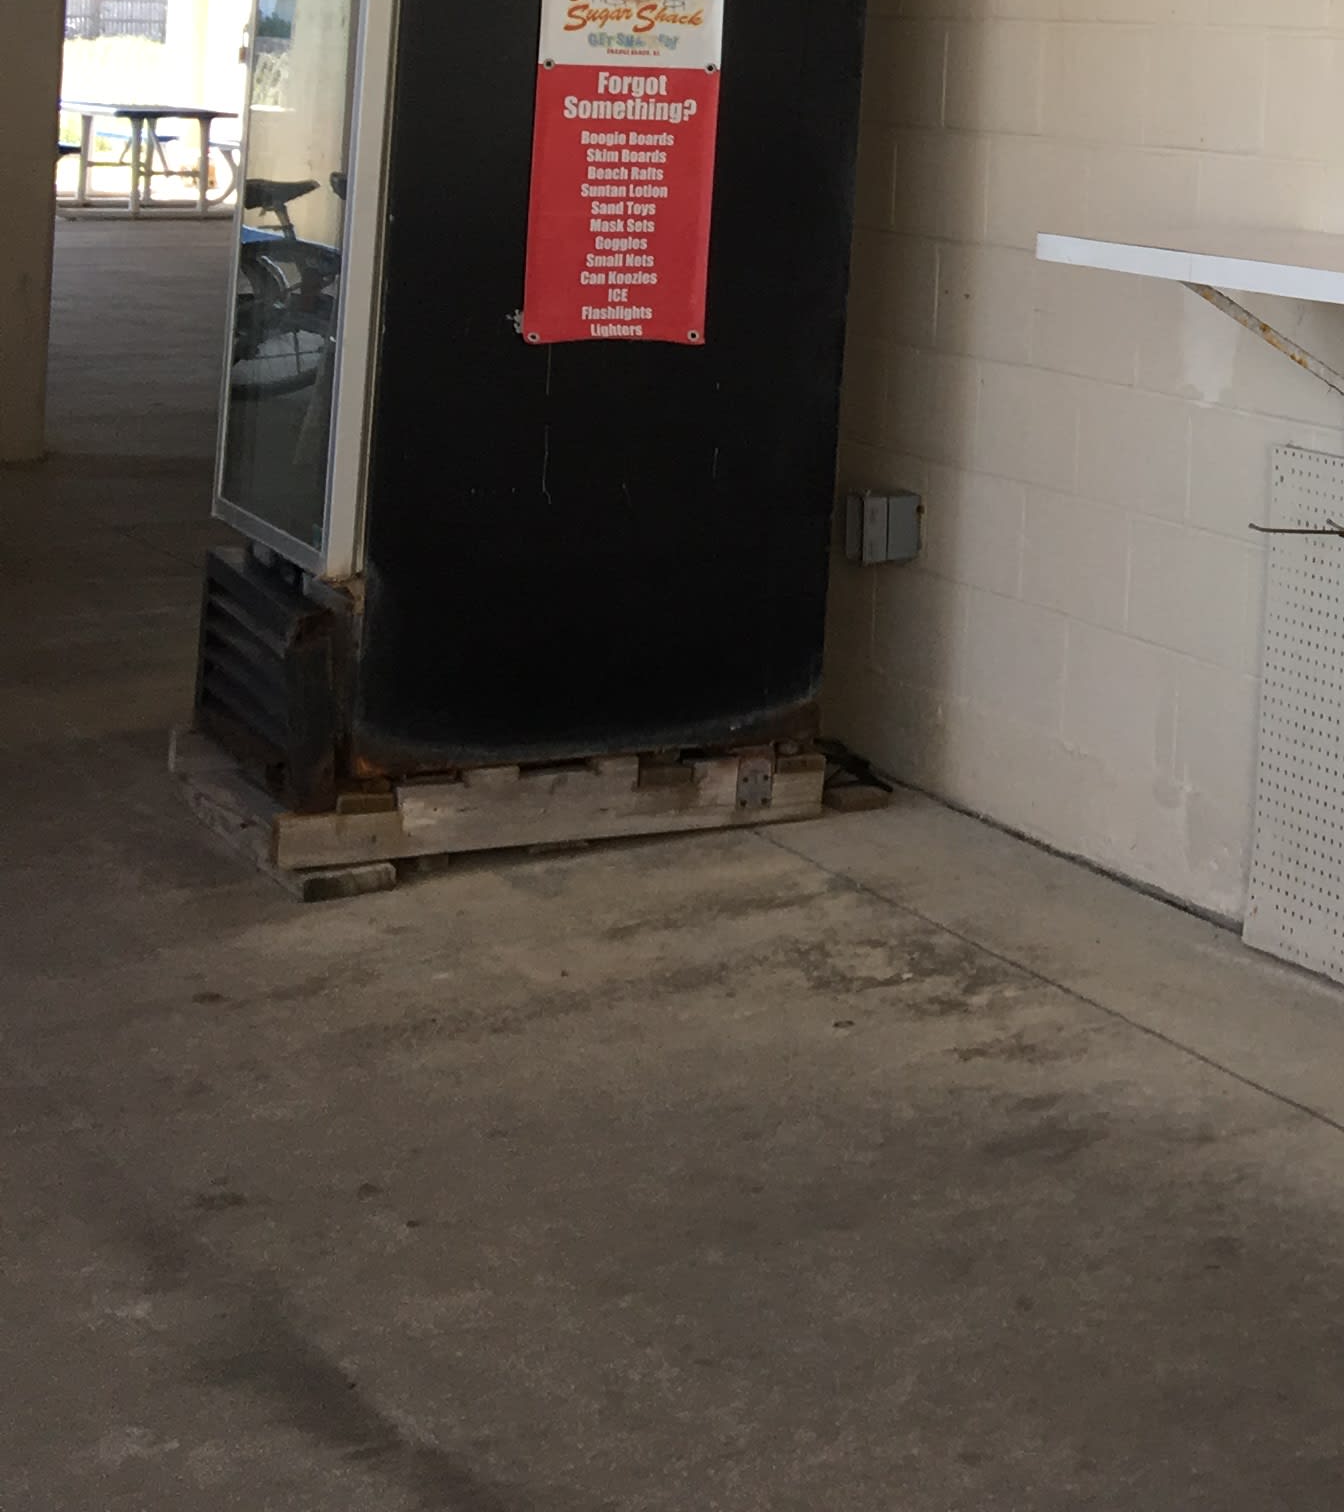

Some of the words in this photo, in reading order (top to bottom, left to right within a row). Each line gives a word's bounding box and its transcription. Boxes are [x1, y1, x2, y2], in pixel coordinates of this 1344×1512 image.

[564, 3, 633, 32] Sugar
[632, 3, 705, 33] Shack
[597, 72, 668, 97] Forgot
[563, 95, 697, 124] Something?
[629, 131, 675, 146] Boards
[586, 148, 619, 163] Skim
[621, 148, 667, 163] Boards
[591, 201, 624, 216] Sand
[626, 201, 656, 217] Toys
[590, 218, 625, 233] Mask
[580, 271, 605, 285] Can
[608, 288, 628, 303] ICE
[582, 306, 653, 321] Flashlights
[590, 323, 643, 338] Lighters
